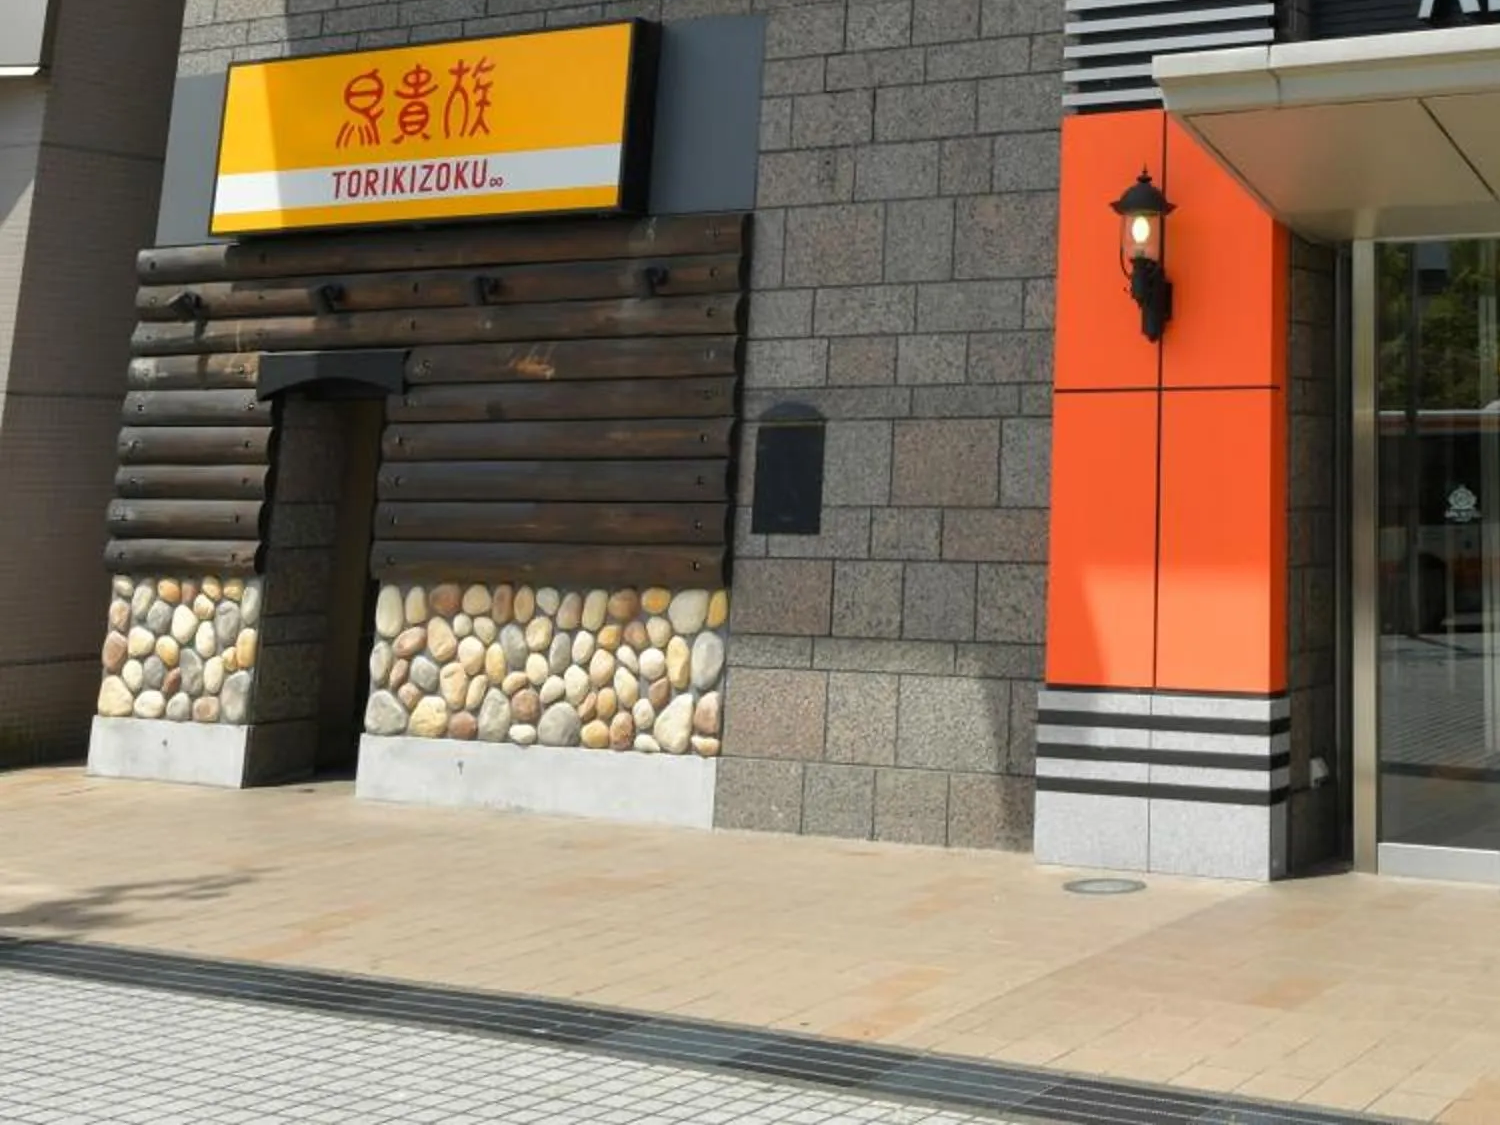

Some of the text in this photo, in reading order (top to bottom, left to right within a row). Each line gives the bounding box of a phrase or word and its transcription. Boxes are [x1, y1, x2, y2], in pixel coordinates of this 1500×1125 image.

[335, 56, 496, 149] 鳥貴族
[332, 158, 490, 200] TORIKIZOKU
